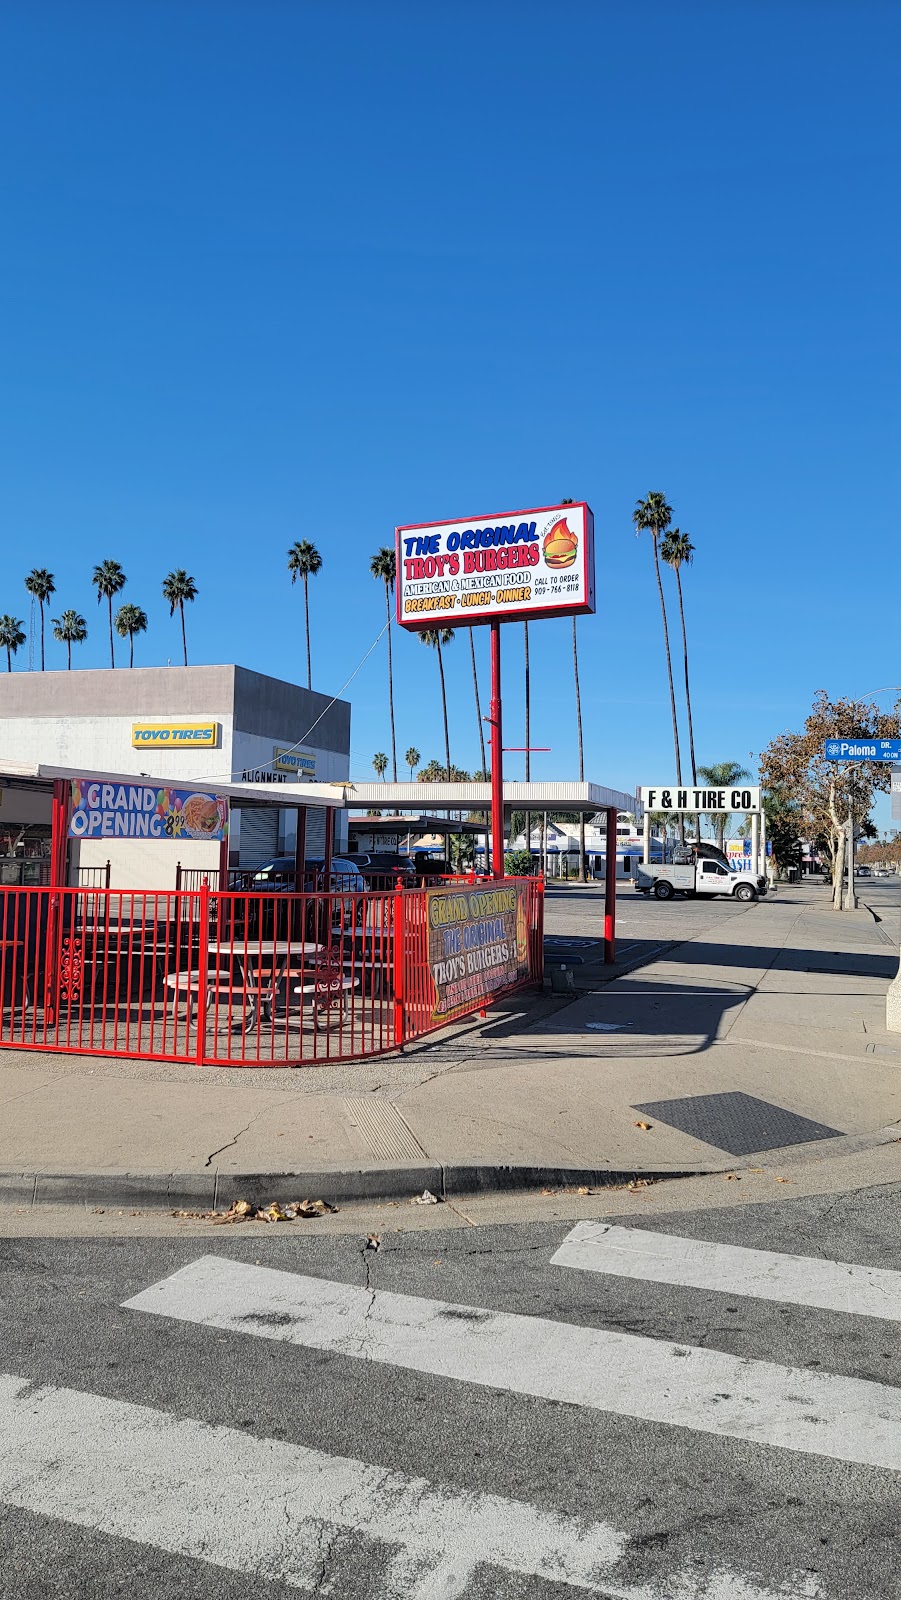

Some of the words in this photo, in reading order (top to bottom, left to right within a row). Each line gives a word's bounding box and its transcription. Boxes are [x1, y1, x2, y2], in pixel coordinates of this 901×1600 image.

[404, 534, 441, 557] THE
[446, 522, 540, 551] ORIGINAL
[404, 553, 460, 580] TROY'S
[463, 543, 540, 574] BURGERS
[404, 580, 450, 596] AMERICAN
[451, 579, 460, 591] &
[461, 574, 502, 590] MEXICAN
[503, 571, 531, 586] FOOD
[534, 577, 548, 586] CALL
[550, 576, 558, 584] TO
[559, 573, 579, 582] ORDER
[404, 594, 457, 613] BREAKFAST
[461, 591, 491, 607] LUNCH
[496, 586, 531, 604] DINNER
[134, 729, 171, 741] TOYO
[171, 728, 213, 740] TIRES
[840, 743, 876, 756] Paloma
[880, 741, 892, 749] DR.
[278, 754, 297, 767] TOYO
[297, 758, 316, 770] TIRES
[241, 769, 288, 783] ALIGNMENT
[87, 783, 156, 812] GRAND
[648, 790, 656, 808] F
[661, 790, 672, 808] &
[677, 790, 687, 808] H
[692, 790, 725, 809] TIRE
[731, 790, 756, 809] CO.
[70, 809, 162, 836] OPENING
[730, 858, 752, 871] ASH
[431, 894, 468, 928] GRAND
[469, 887, 517, 919] OPENING
[443, 927, 460, 957] THE
[463, 918, 507, 950] ORIGINAL
[433, 955, 466, 985] TROY'S
[467, 942, 509, 973] BURGERS
